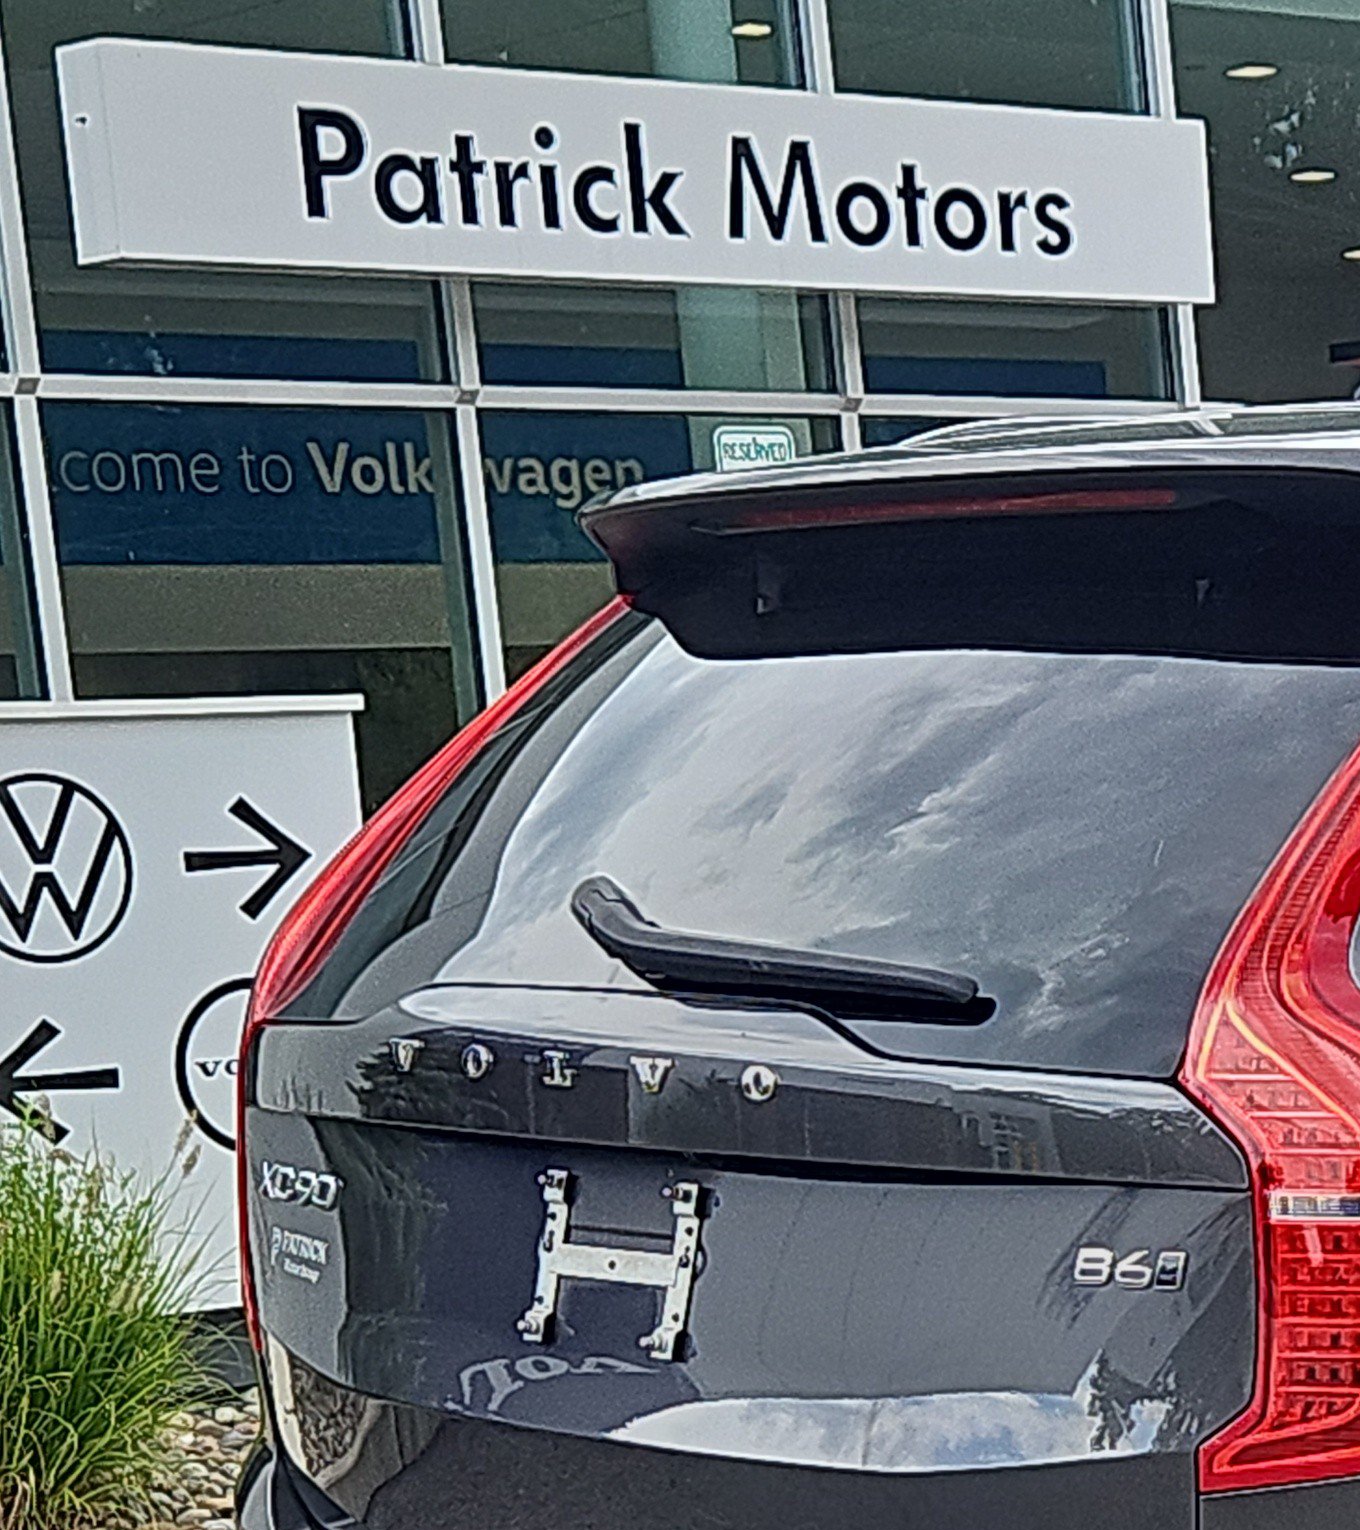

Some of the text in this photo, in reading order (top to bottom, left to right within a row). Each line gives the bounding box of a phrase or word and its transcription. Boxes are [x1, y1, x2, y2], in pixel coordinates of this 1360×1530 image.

[297, 105, 1073, 256] Patrick Motors
[52, 441, 644, 509] come to Volkwagen
[389, 1037, 779, 1101] VOLVO
[259, 1161, 341, 1209] XC90
[1074, 1247, 1153, 1288] B6
